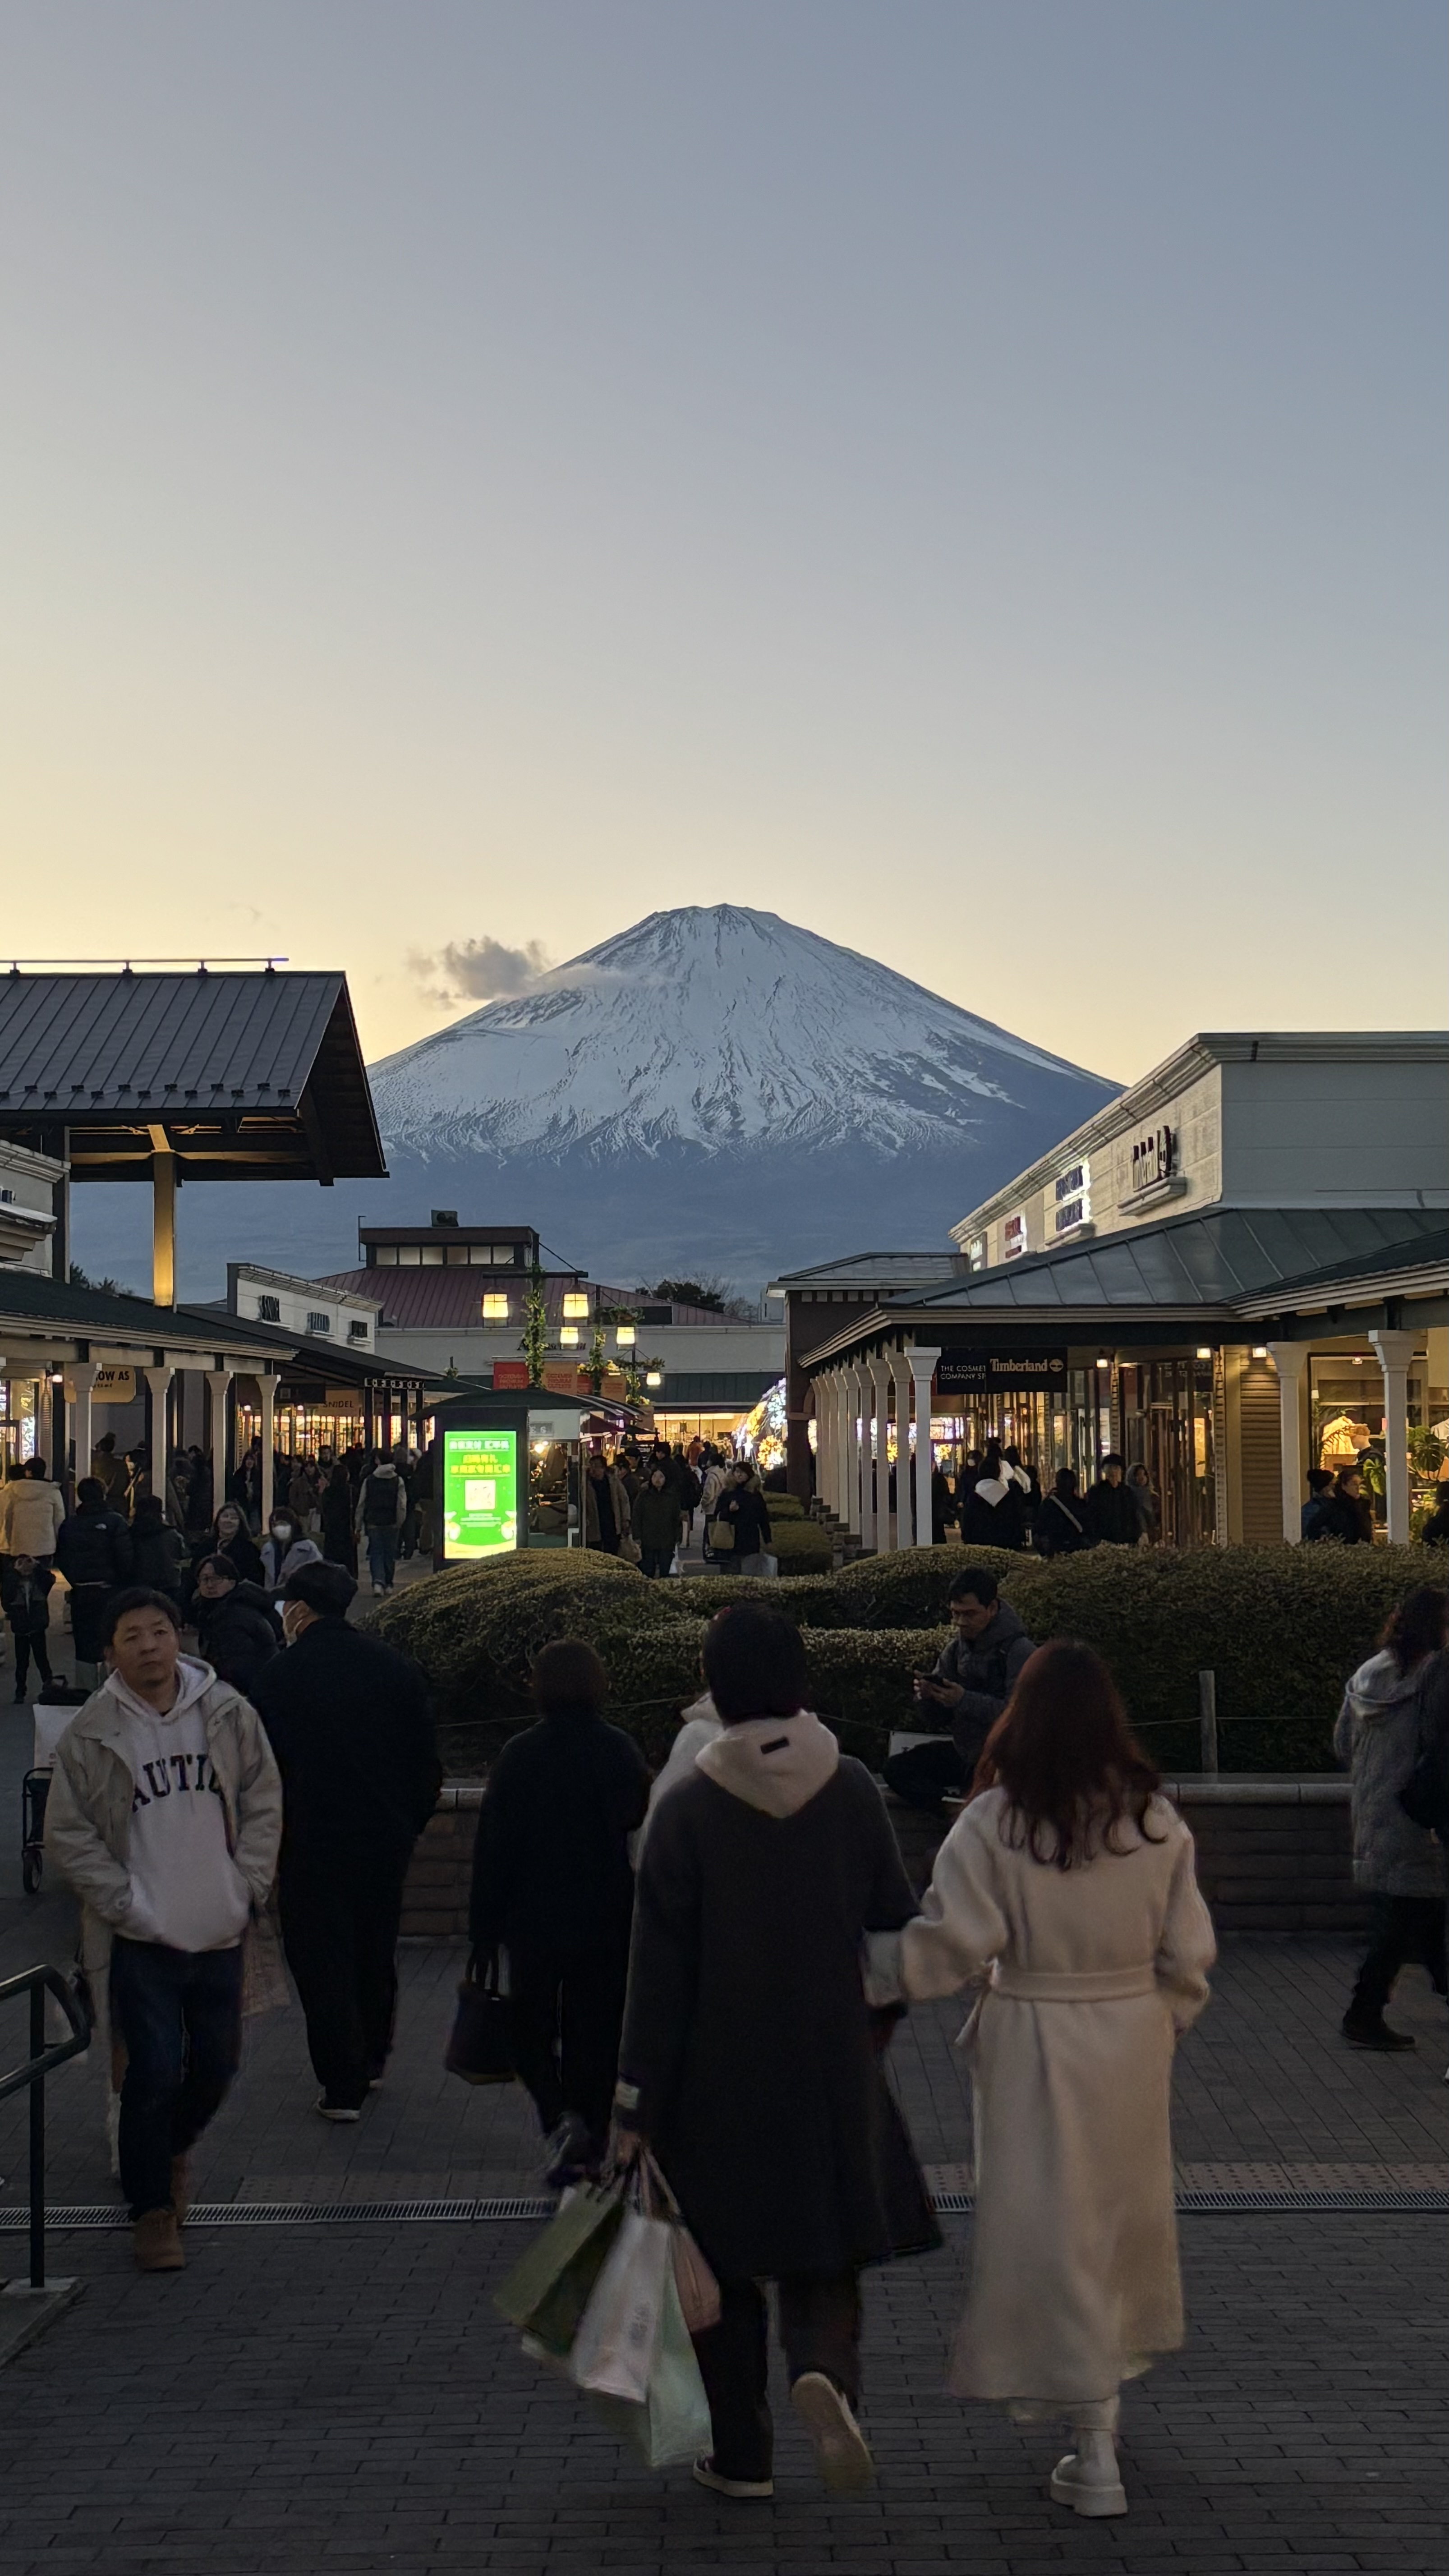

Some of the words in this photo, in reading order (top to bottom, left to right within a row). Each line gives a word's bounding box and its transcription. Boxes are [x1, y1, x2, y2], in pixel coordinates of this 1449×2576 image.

[990, 1358, 1048, 1372] Timberland
[118, 1371, 130, 1381] AS
[323, 1400, 354, 1408] SNIDEL
